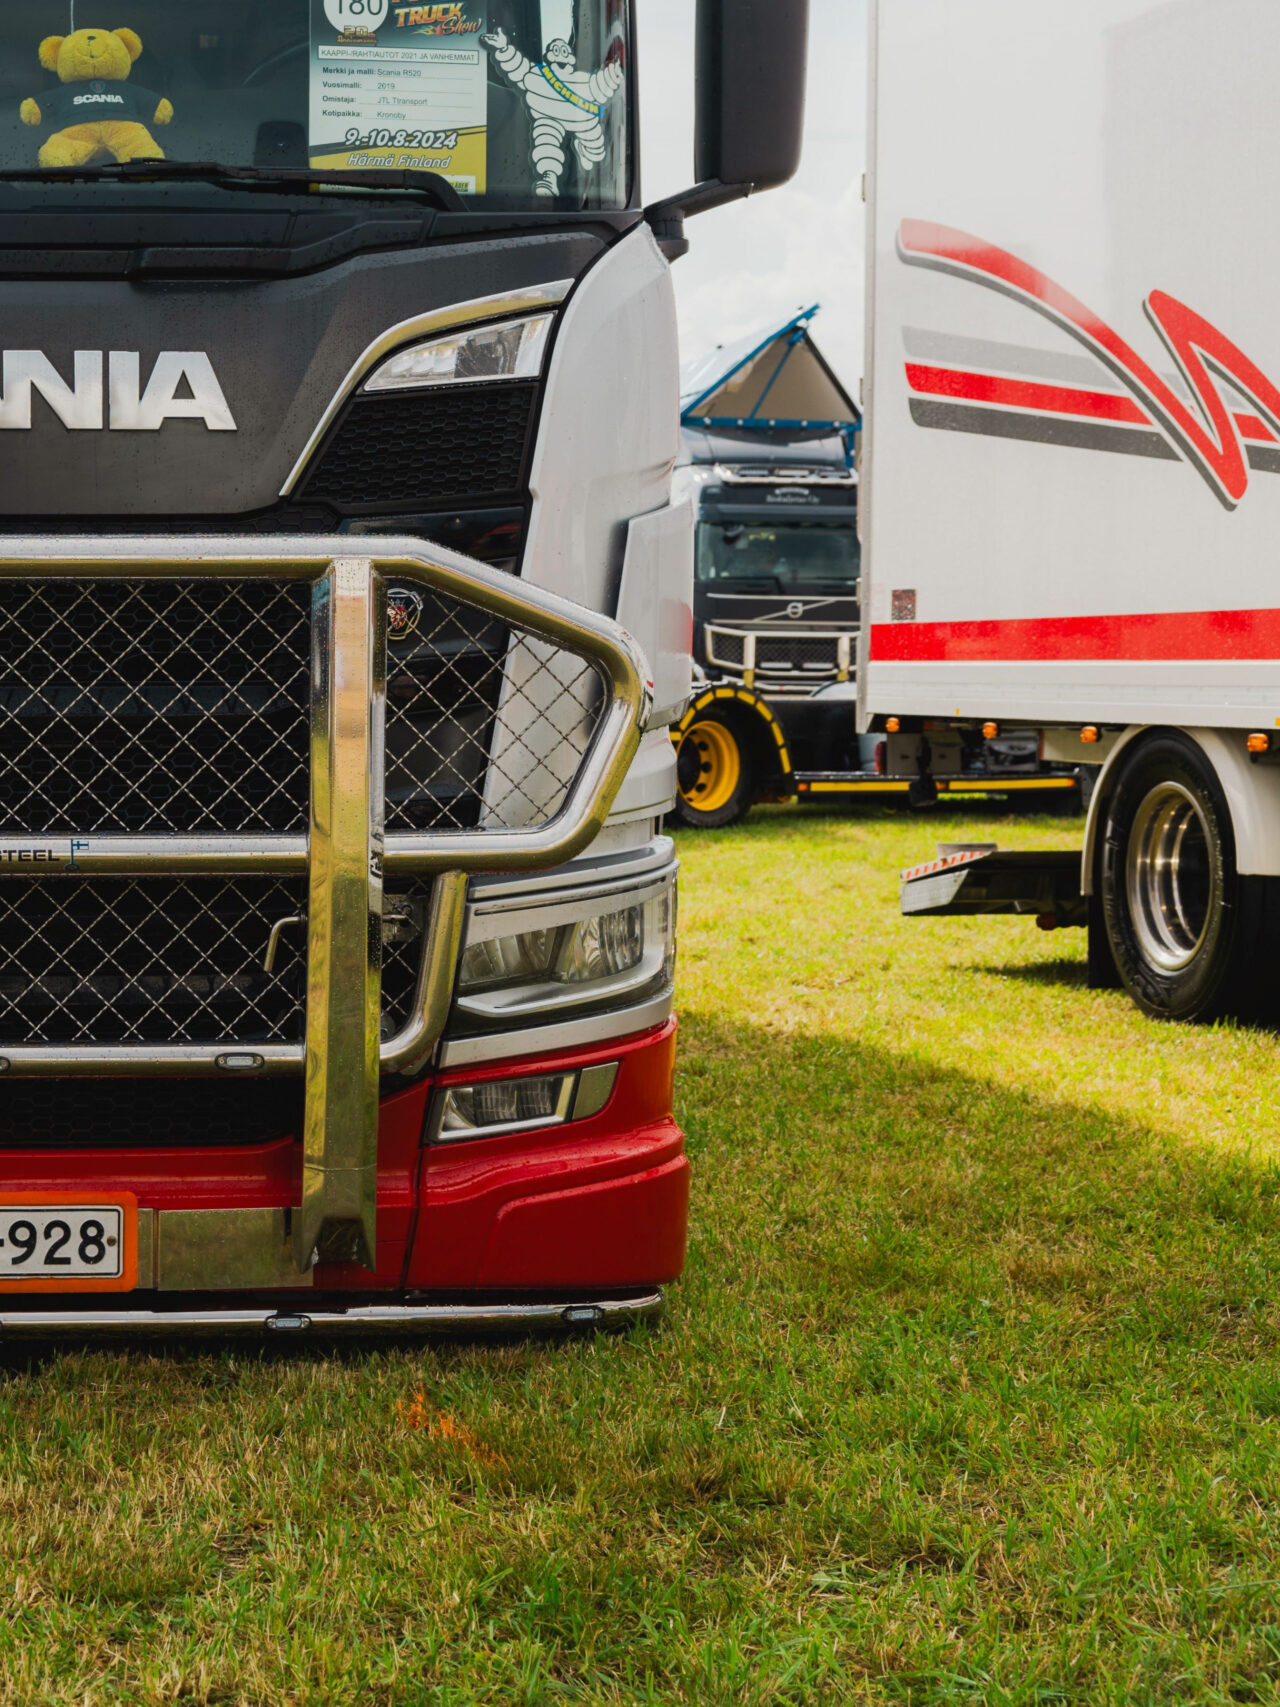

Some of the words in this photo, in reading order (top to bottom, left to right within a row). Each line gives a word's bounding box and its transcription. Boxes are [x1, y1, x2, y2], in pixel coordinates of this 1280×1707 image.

[395, 3, 464, 27] TRUCK
[441, 15, 482, 36] Show
[401, 51, 417, 59] 2021
[419, 52, 429, 60] JA
[430, 53, 475, 62] VANHEMMAT
[322, 66, 347, 75] Merkki
[348, 68, 355, 76] ja
[377, 69, 401, 77] Scania
[322, 81, 362, 89] Vuosimalli:
[377, 82, 395, 90] 2019
[541, 65, 600, 115] MICHELIN
[73, 93, 124, 105] SCANIA
[322, 95, 356, 104] Omistaja:
[322, 110, 362, 118] Kotipaikka:
[376, 111, 407, 120] Kronoby
[345, 128, 458, 149] 9.-10.8.2024
[347, 153, 395, 167] Härmä
[397, 154, 451, 169] Finland
